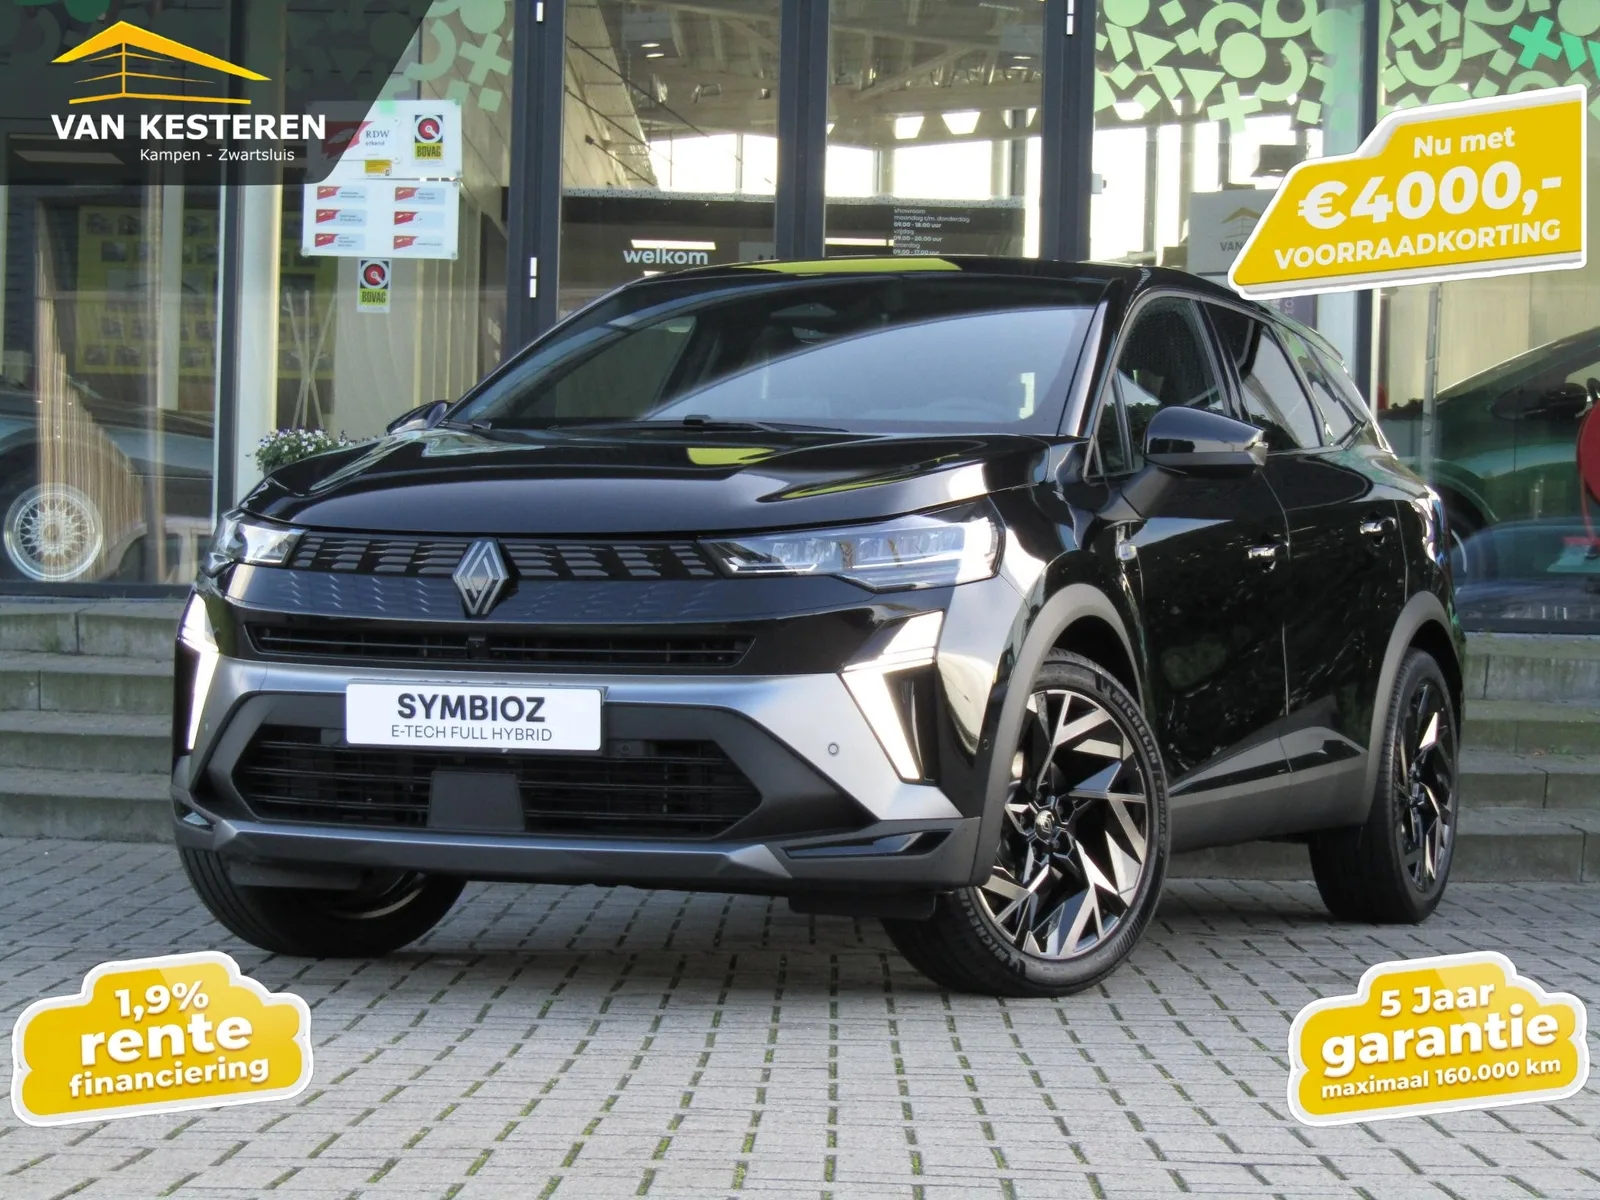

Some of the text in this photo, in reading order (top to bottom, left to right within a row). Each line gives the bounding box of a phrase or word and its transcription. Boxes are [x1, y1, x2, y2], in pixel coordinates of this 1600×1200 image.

[365, 130, 390, 139] RDW
[417, 145, 441, 157] BOVAG
[623, 247, 708, 264] welkom
[362, 291, 386, 303] BOVAG
[398, 693, 545, 722] SYMBIOZ
[392, 725, 551, 741] E-TECH FULL HYBRID
[1112, 691, 1158, 763] MICHELIN
